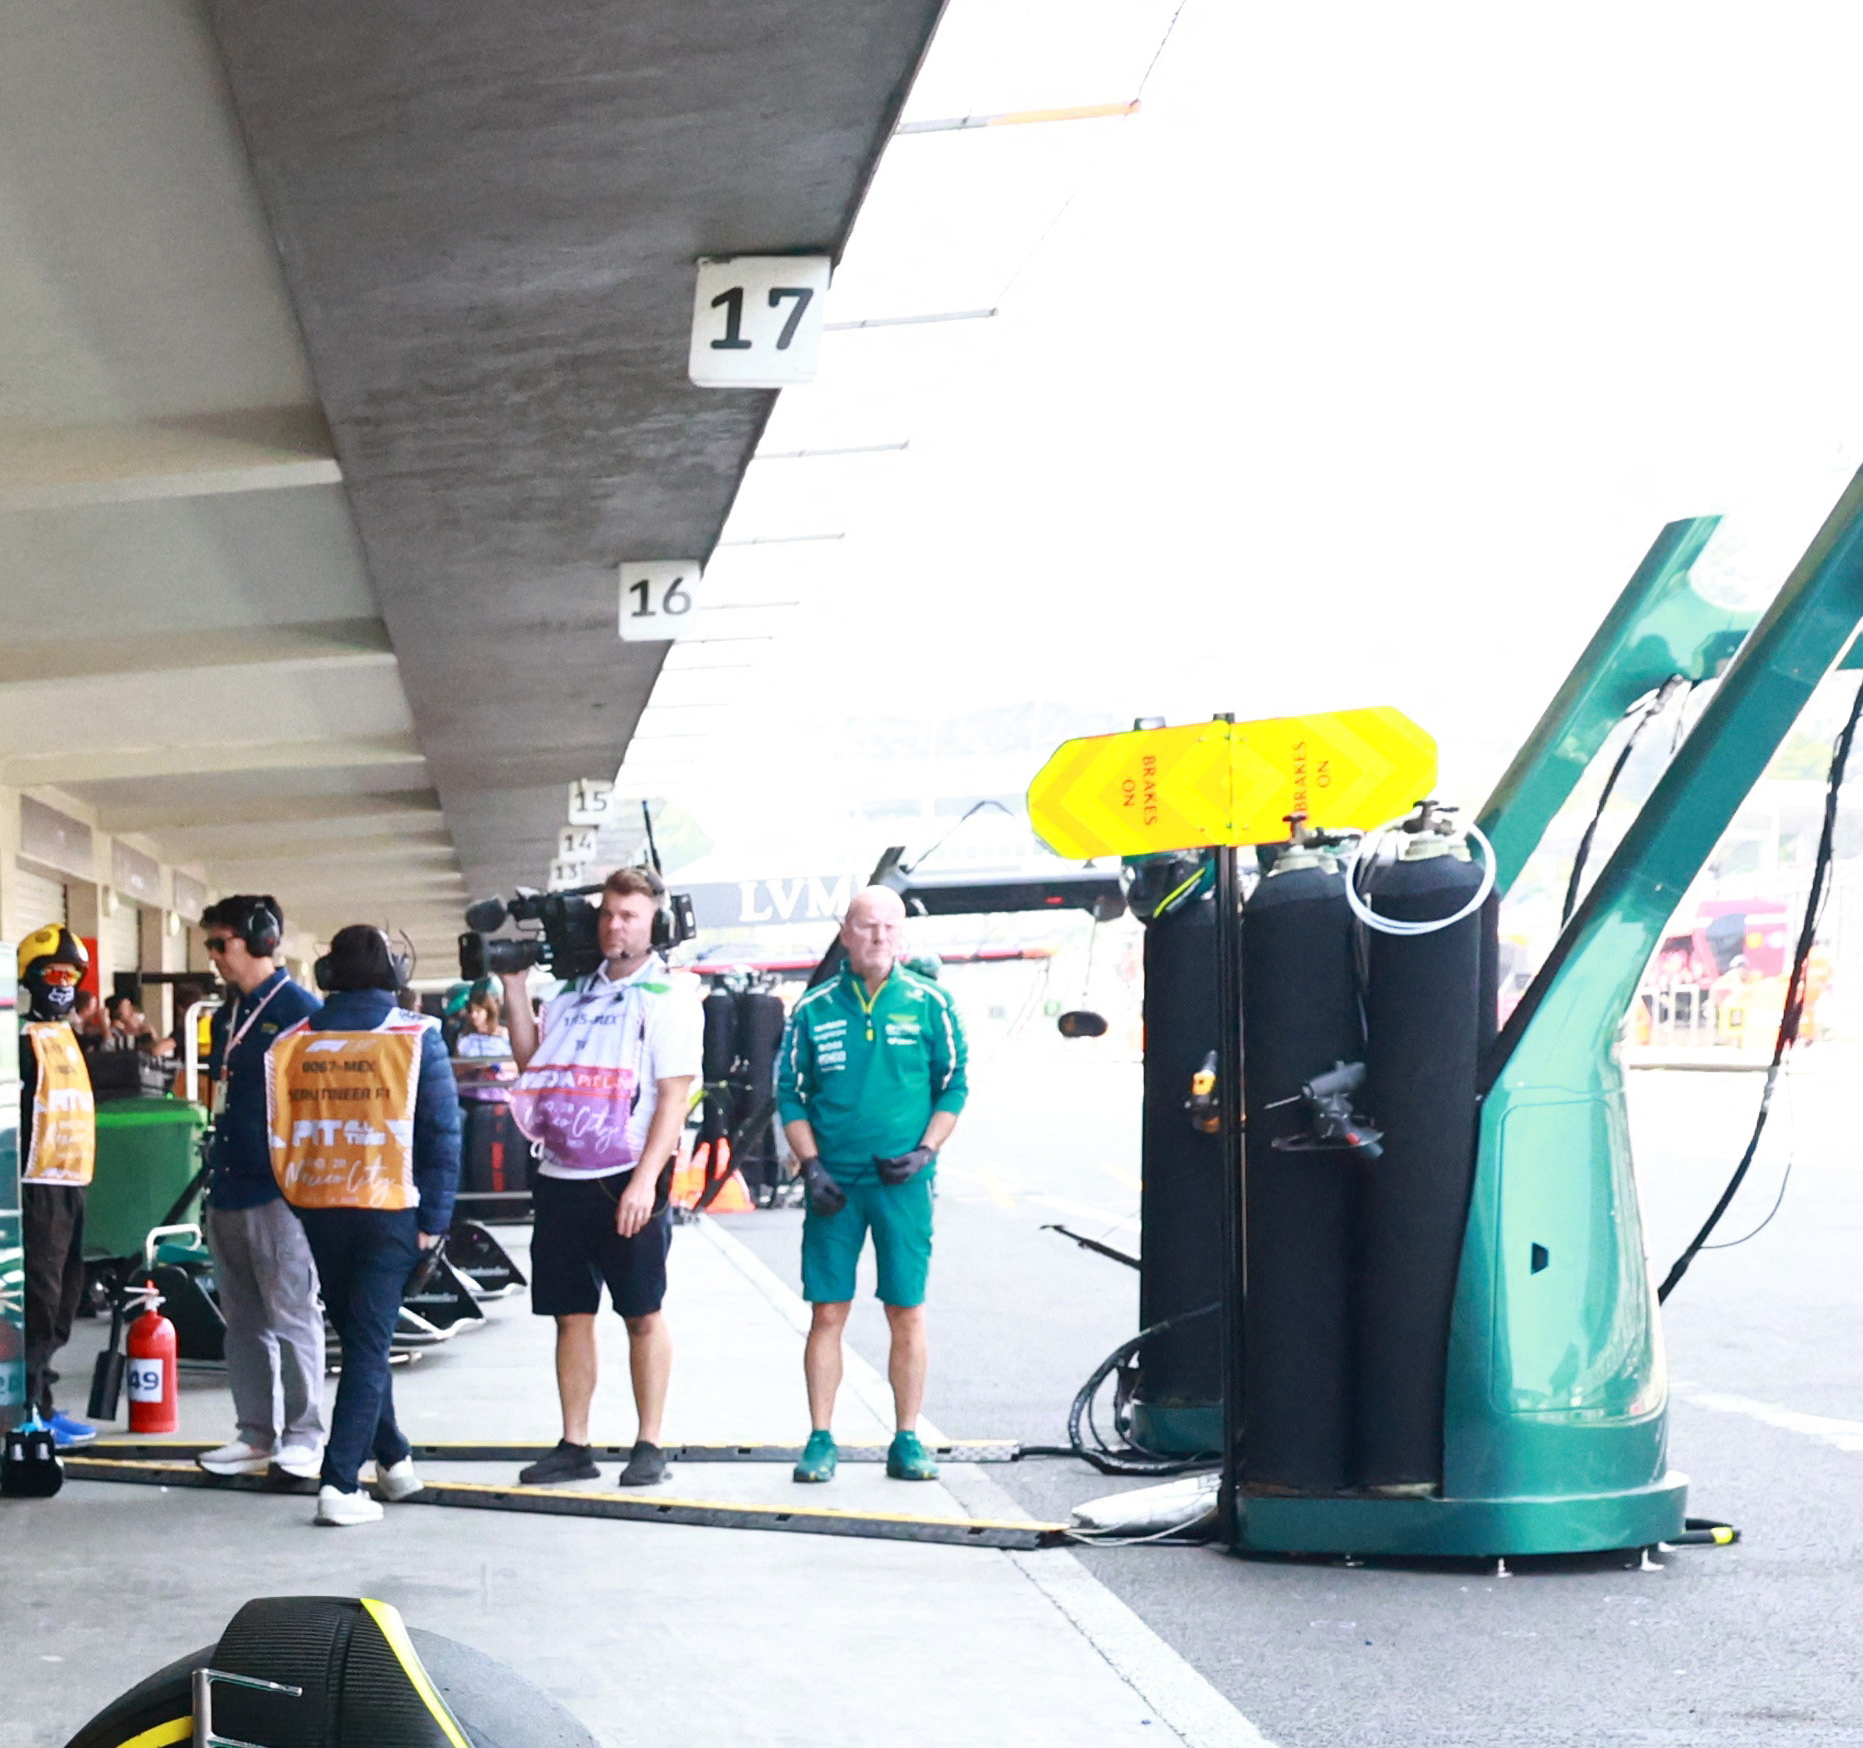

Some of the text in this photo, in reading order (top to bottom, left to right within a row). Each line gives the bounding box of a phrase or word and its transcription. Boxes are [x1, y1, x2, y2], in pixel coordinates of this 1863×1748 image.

[710, 287, 814, 350] 17
[629, 577, 692, 617] 16
[1123, 755, 1158, 826] BRAKES ON
[1293, 741, 1331, 812] BRAKES ON
[574, 788, 608, 812] 15
[564, 833, 592, 851] 14
[739, 874, 870, 922] LVM
[292, 1120, 343, 1147] PIT
[128, 1370, 159, 1391] 49
